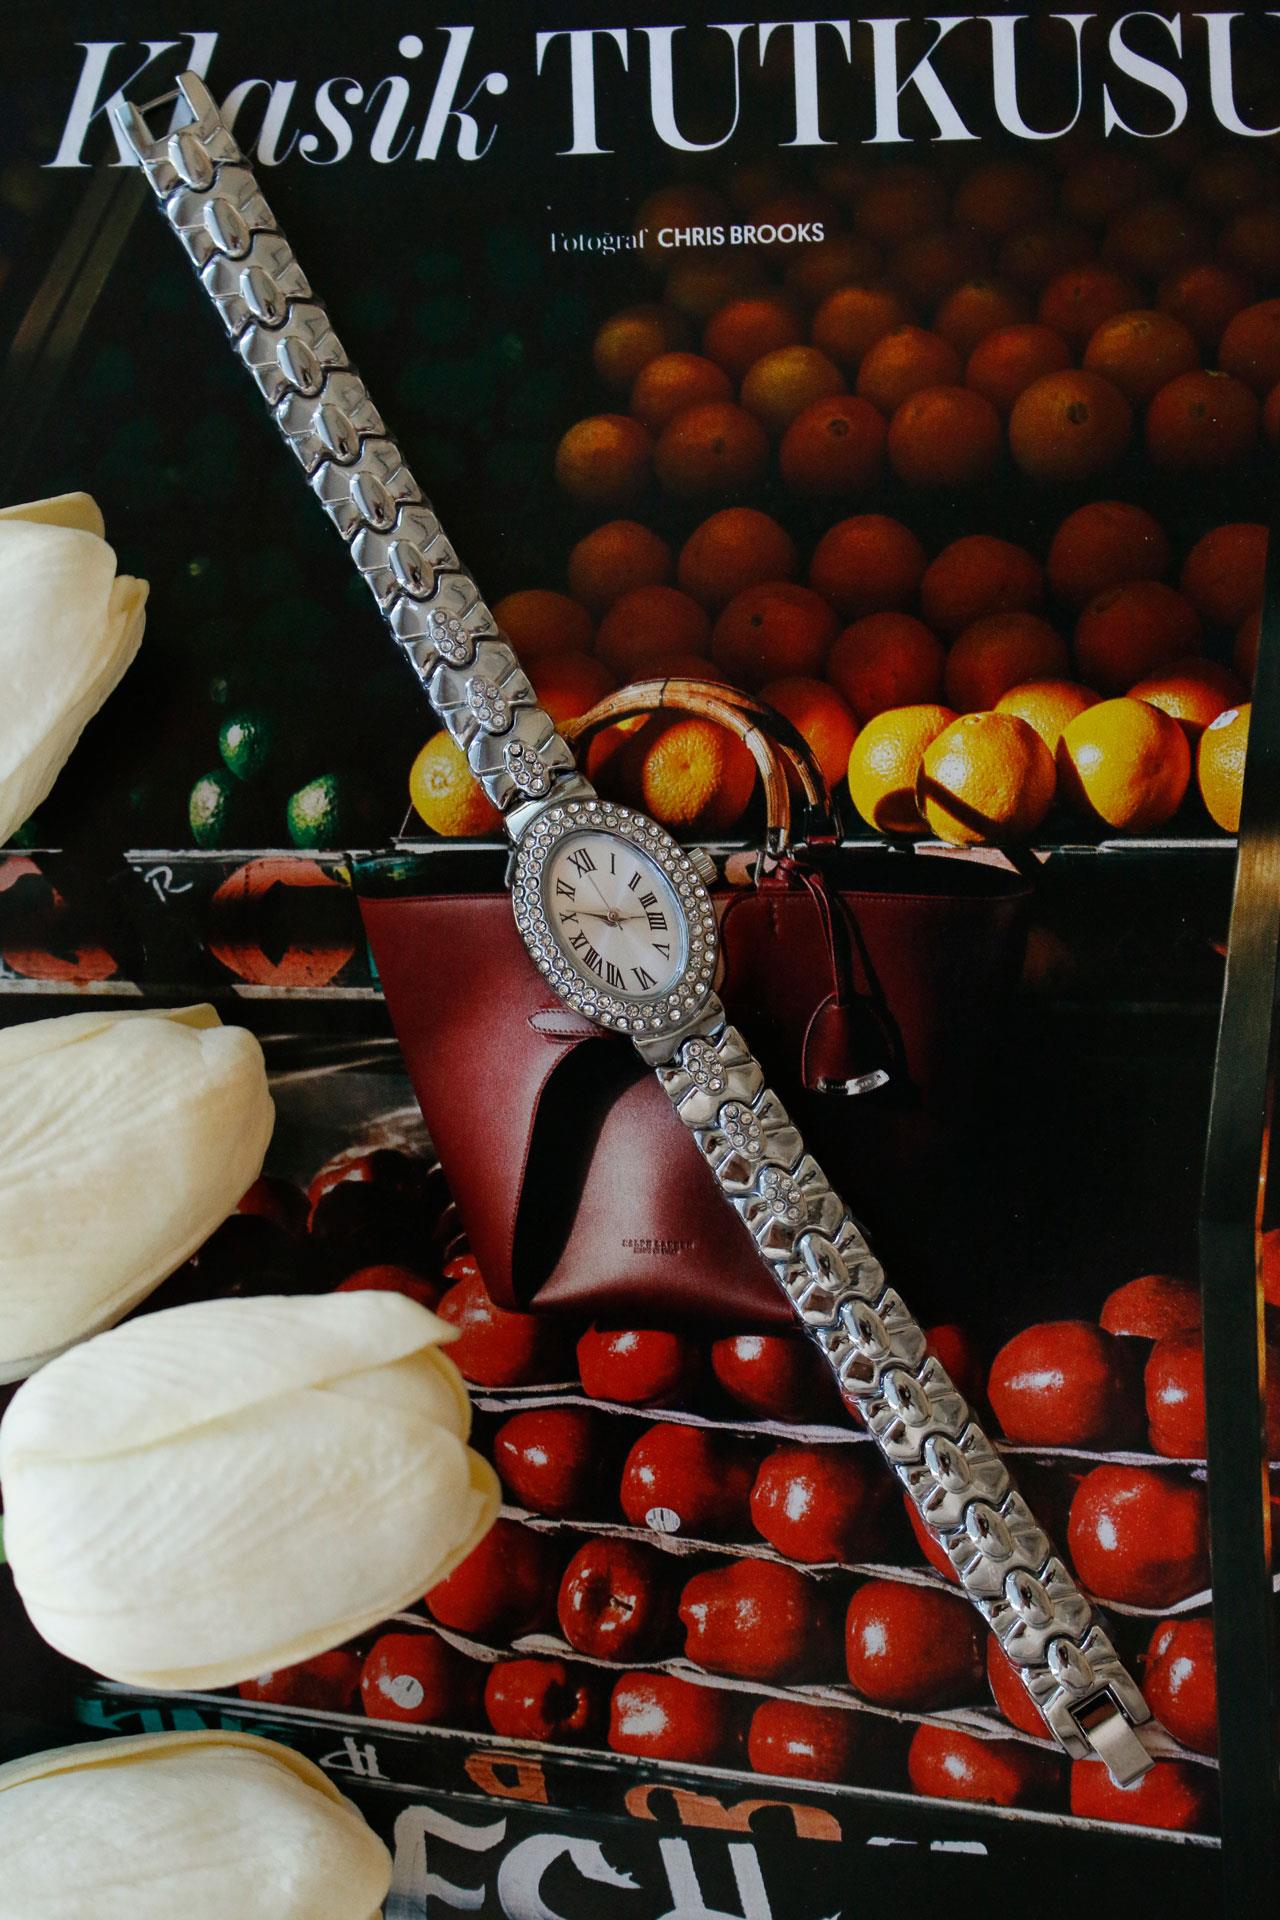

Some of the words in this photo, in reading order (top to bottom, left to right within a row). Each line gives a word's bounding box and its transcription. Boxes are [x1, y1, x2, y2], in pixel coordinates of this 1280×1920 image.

[40, 26, 508, 168] Klasik
[550, 230, 649, 255] Fotoğraf
[657, 227, 725, 248] CHRIS
[730, 222, 824, 246] BROOKS
[567, 848, 597, 878] XII
